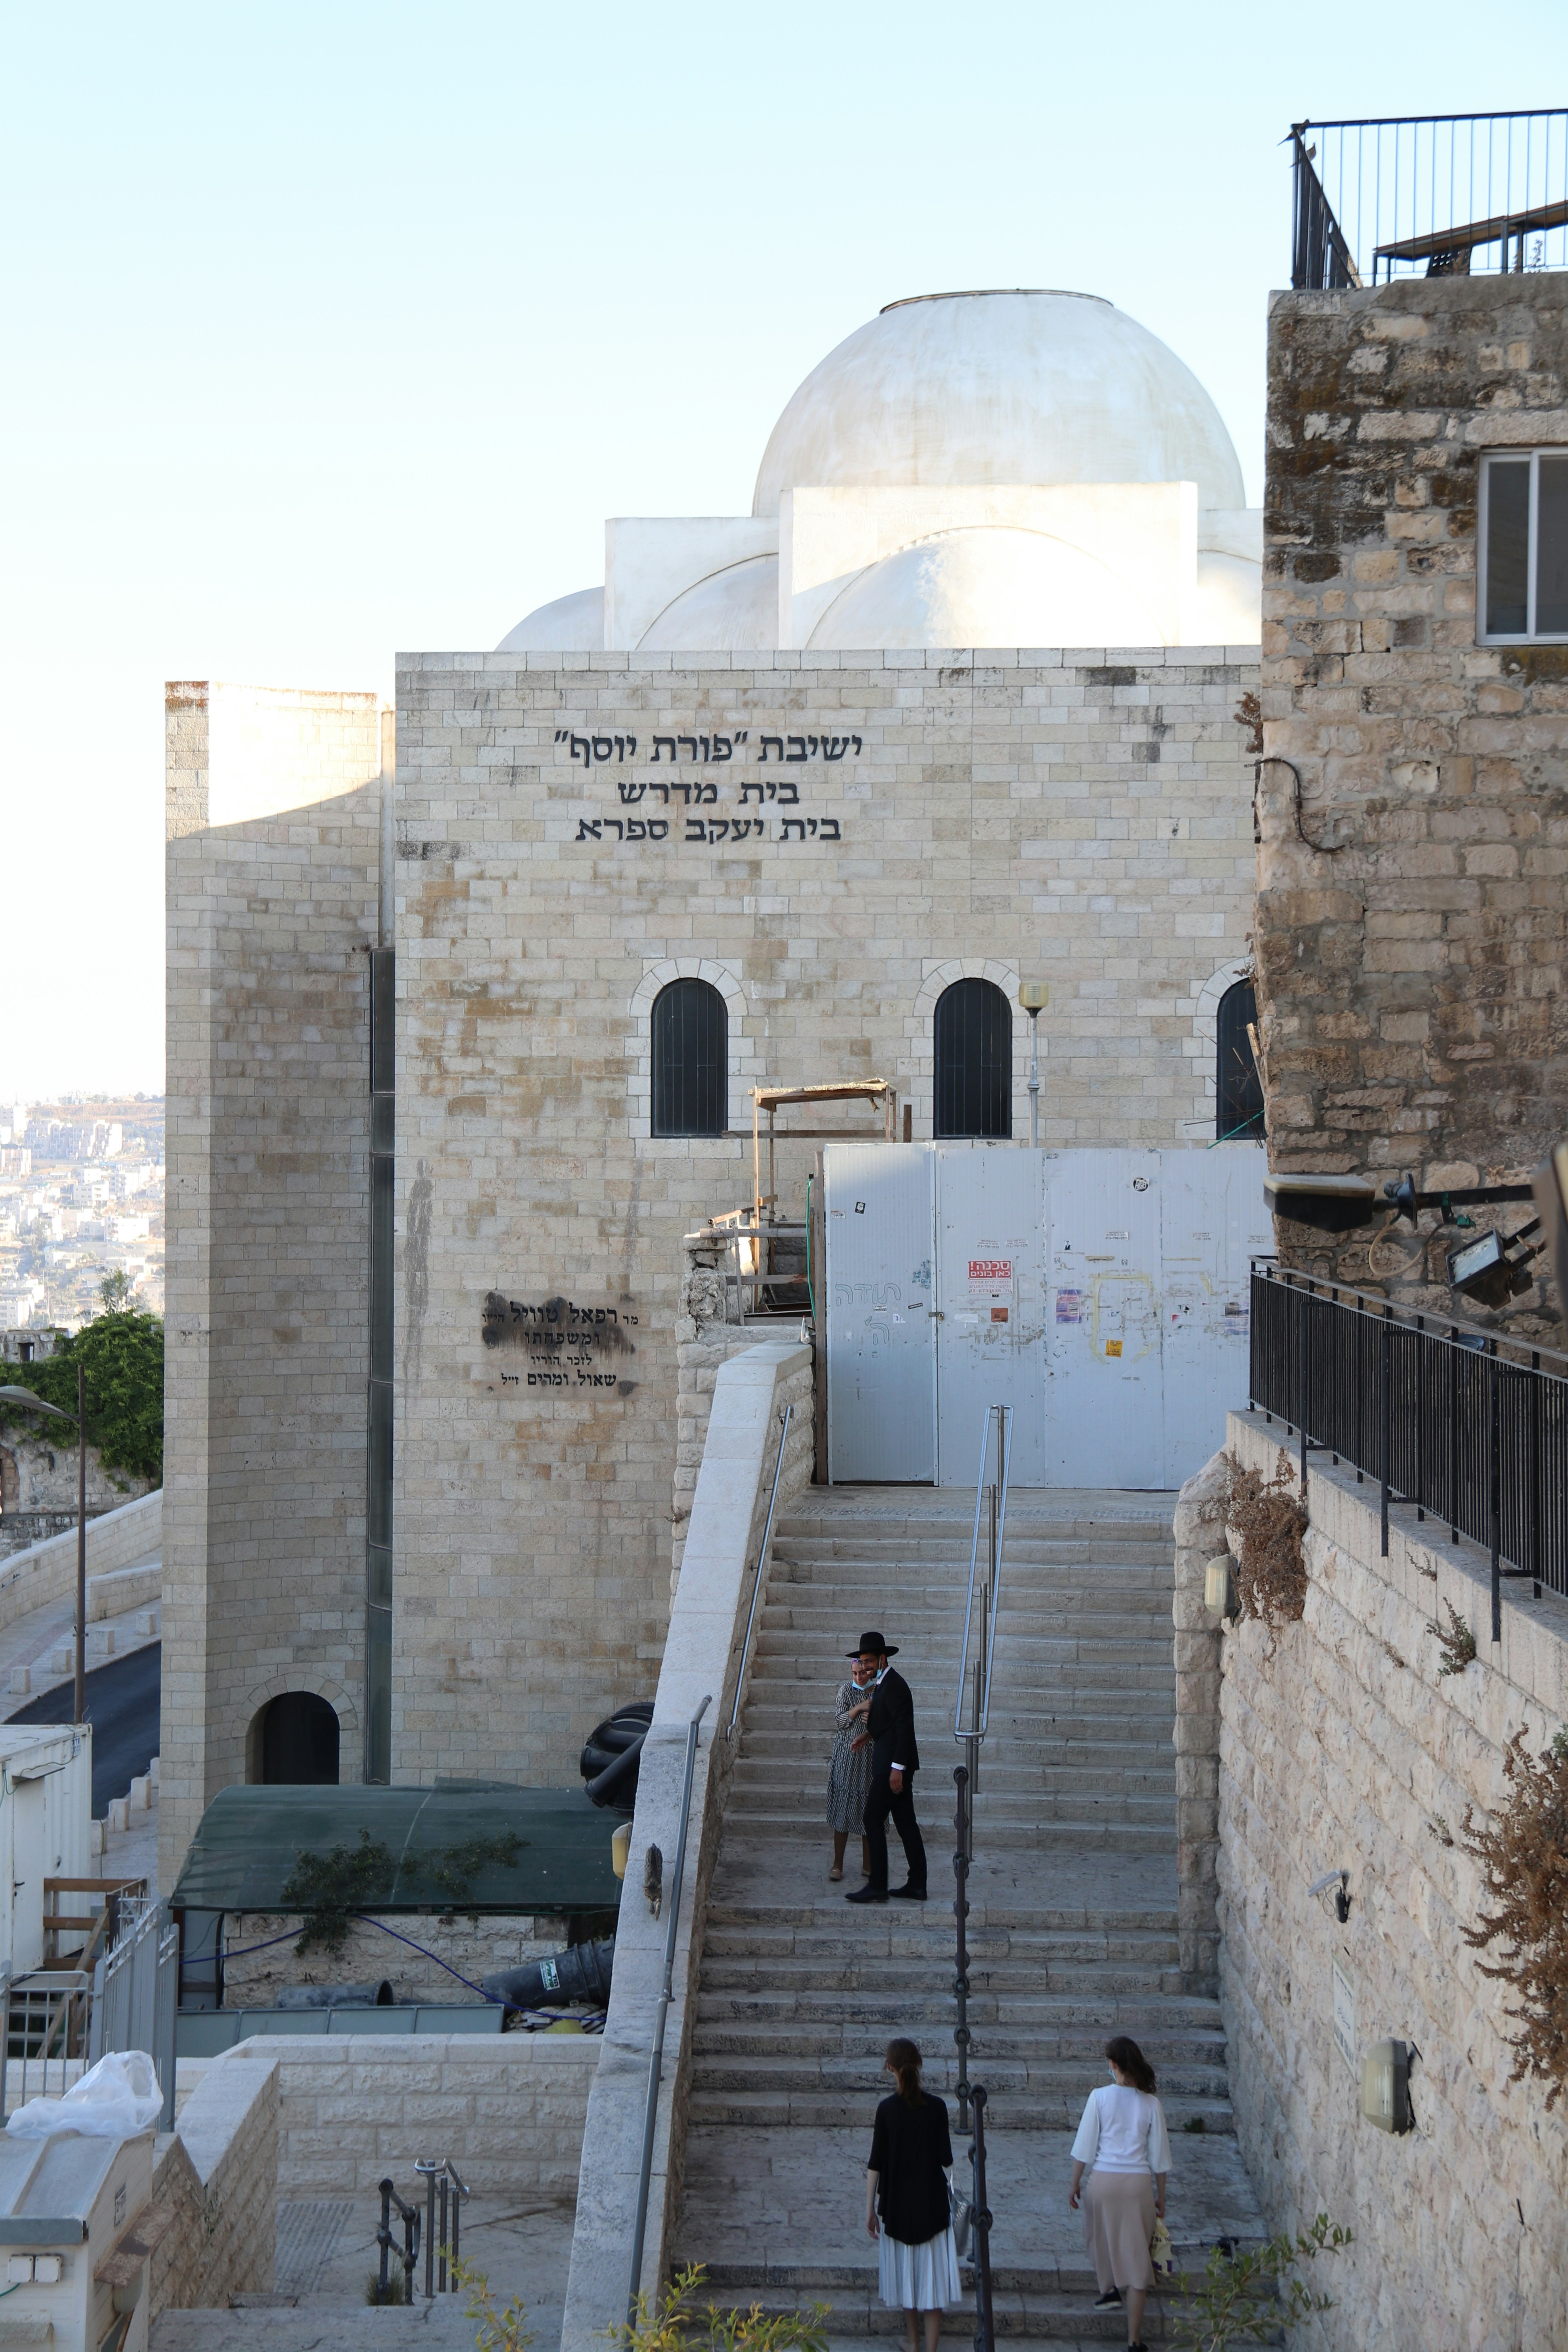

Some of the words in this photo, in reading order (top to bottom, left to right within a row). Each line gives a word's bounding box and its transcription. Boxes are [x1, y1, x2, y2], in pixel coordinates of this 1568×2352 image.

[555, 730, 637, 768] יוסף"
[650, 731, 748, 762] "פורת
[757, 735, 862, 762] ישיבת
[618, 782, 717, 805] מדרש
[738, 782, 799, 804] בית
[575, 818, 668, 841] ספרא
[685, 818, 764, 844] יעקב
[779, 818, 841, 840] בית
[970, 1261, 1010, 1270] סכנה!
[836, 1283, 901, 1307] תודה
[510, 1301, 559, 1324] טוויל
[568, 1302, 617, 1325] רפאל
[622, 1315, 639, 1325] מר
[524, 1332, 600, 1345] ומשפחתו
[531, 1356, 560, 1366] הוריו
[567, 1354, 592, 1366] לזכר
[527, 1373, 569, 1386] ומרים
[577, 1369, 616, 1387] שאול
